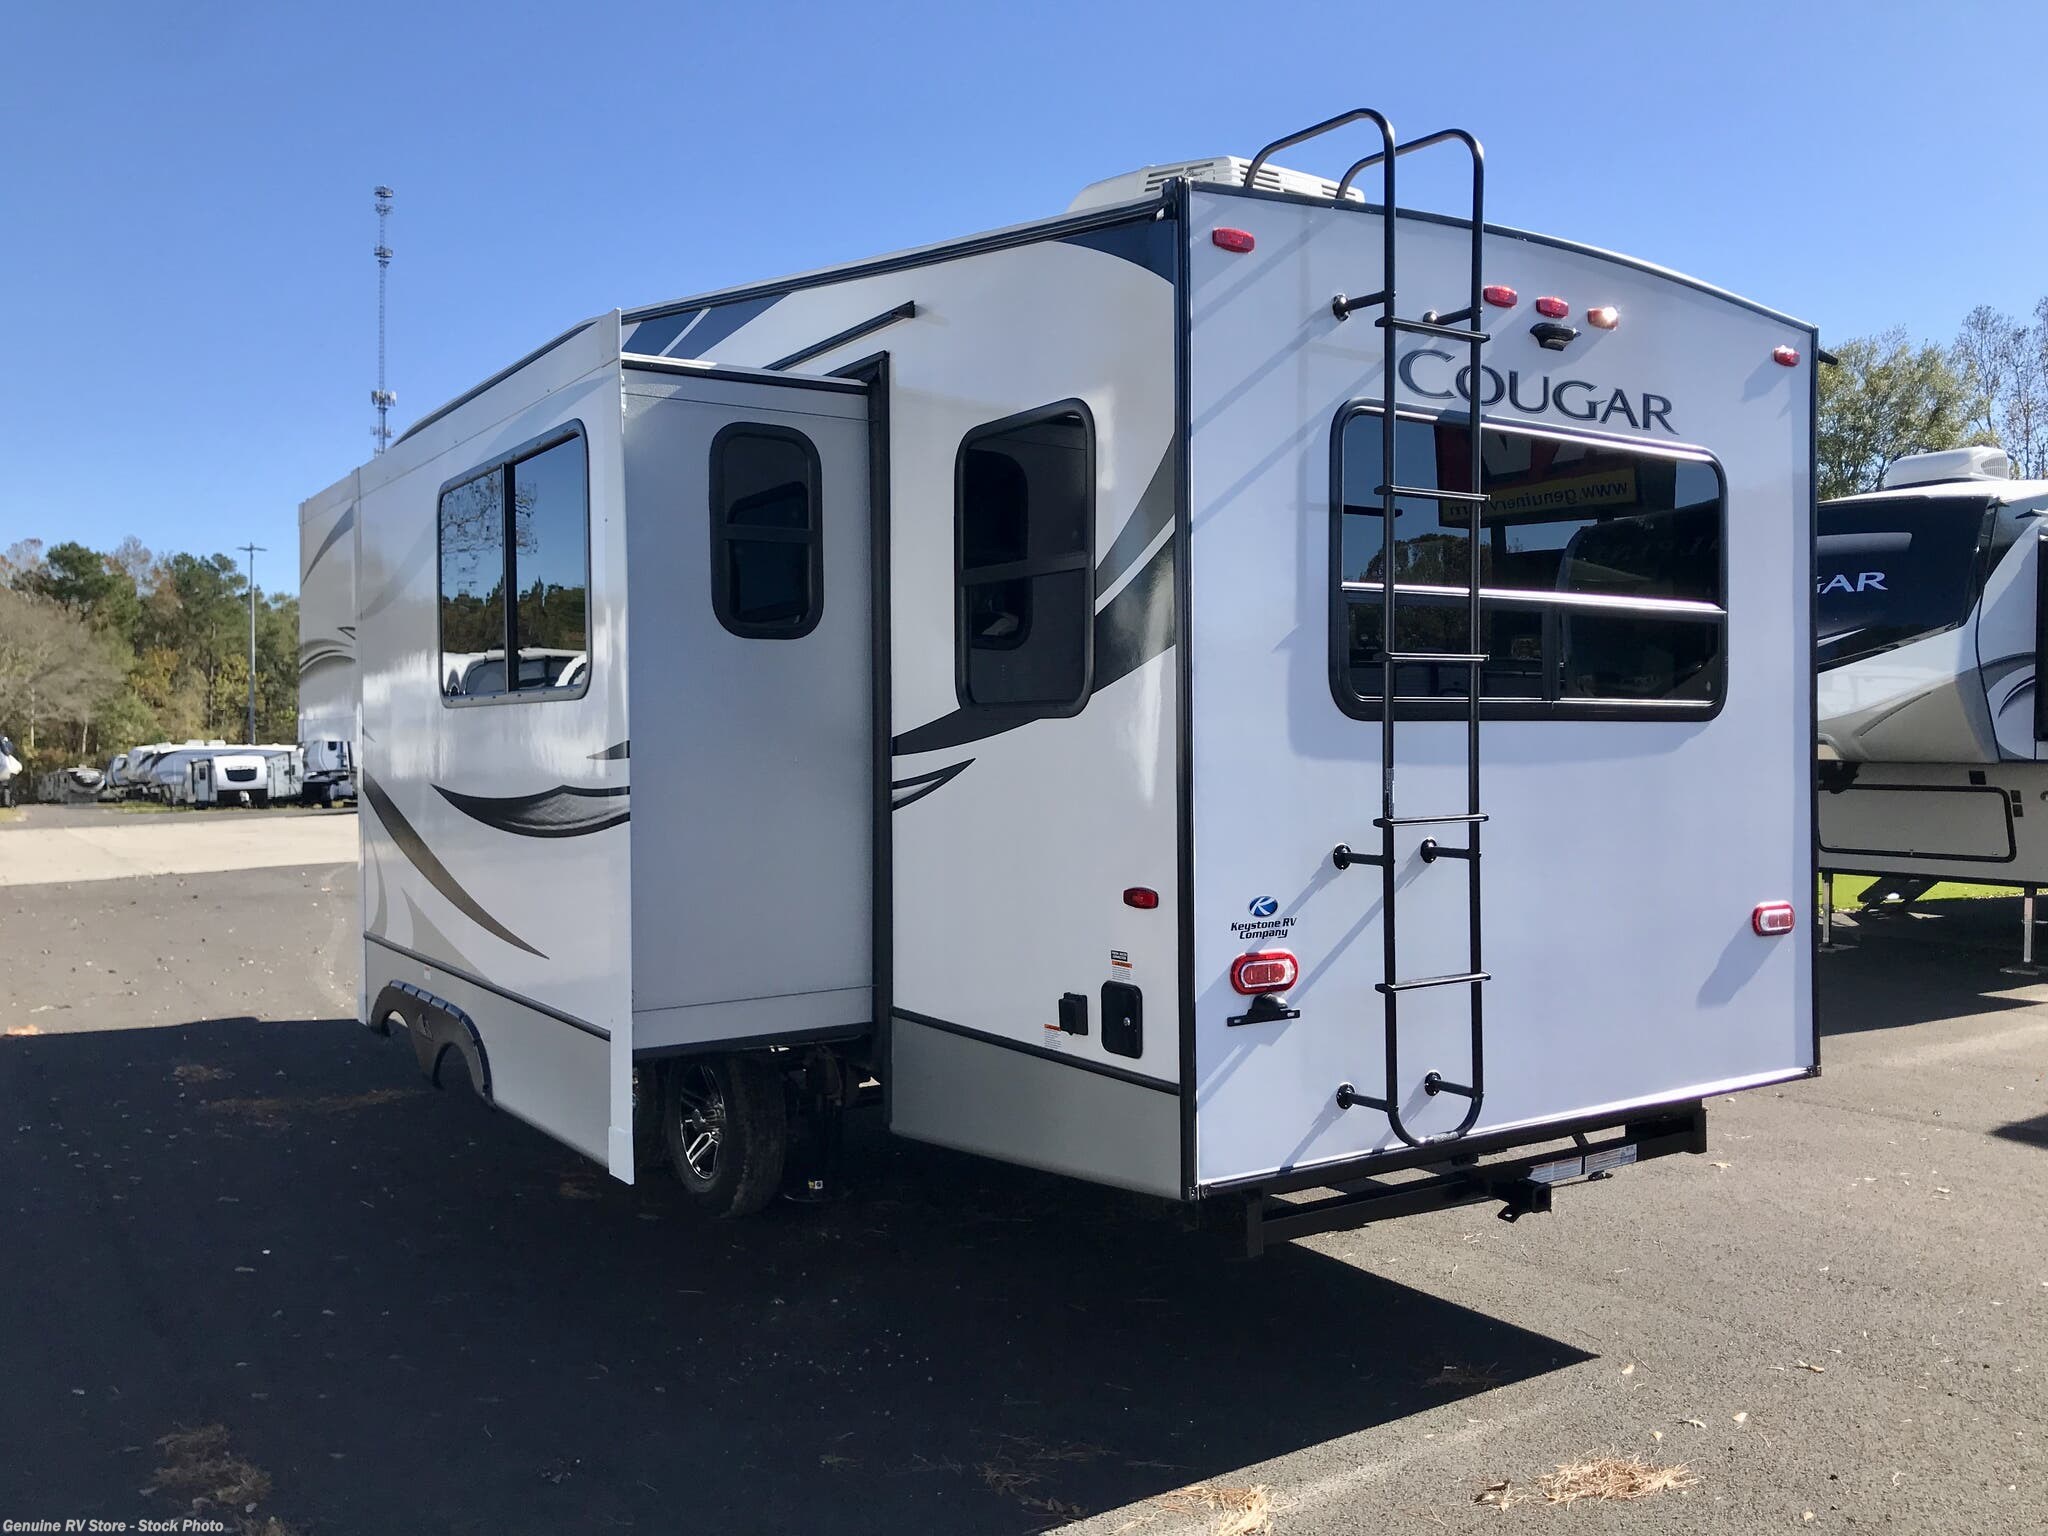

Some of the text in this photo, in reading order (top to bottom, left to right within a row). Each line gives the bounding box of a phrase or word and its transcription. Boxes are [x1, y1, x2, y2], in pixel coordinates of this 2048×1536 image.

[1398, 349, 1680, 435] COUGAR
[1817, 571, 1889, 595] AR
[1230, 917, 1298, 932] Keystone RV
[1239, 928, 1289, 940] Company
